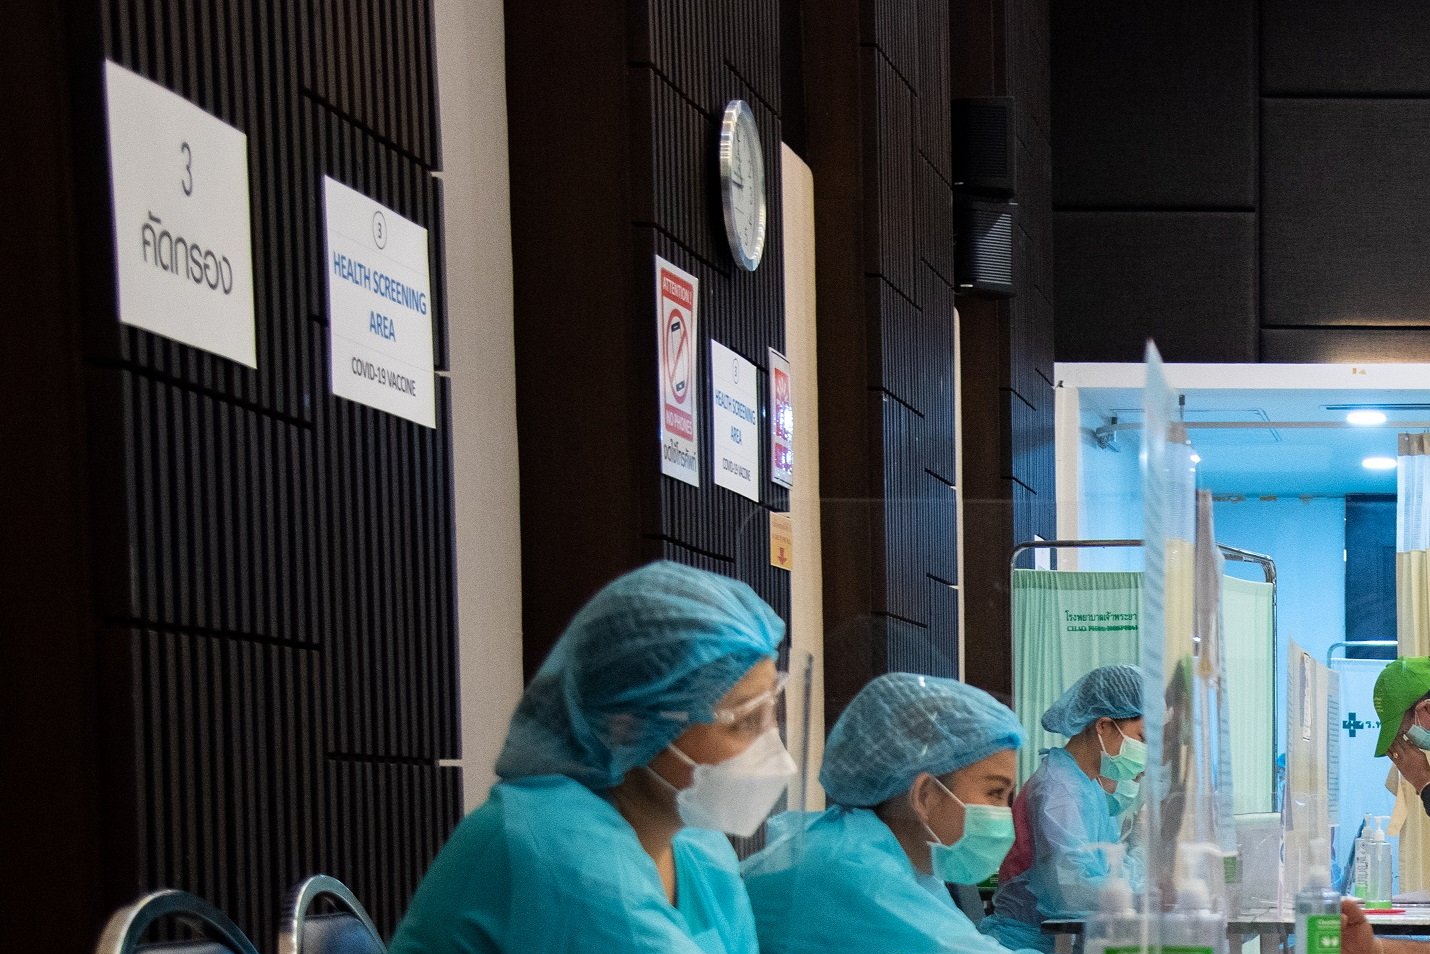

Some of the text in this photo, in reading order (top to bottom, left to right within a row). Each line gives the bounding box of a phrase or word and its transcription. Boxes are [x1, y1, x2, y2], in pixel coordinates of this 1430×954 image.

[181, 141, 193, 197] 3
[141, 210, 233, 295] คัดกรอง
[333, 251, 427, 316] HEALTH SCREENING
[369, 310, 396, 343] AREA
[351, 356, 417, 397] COVID-19 VACCINE
[715, 389, 756, 426] HEALTH SCREENING
[731, 425, 743, 445] AREA
